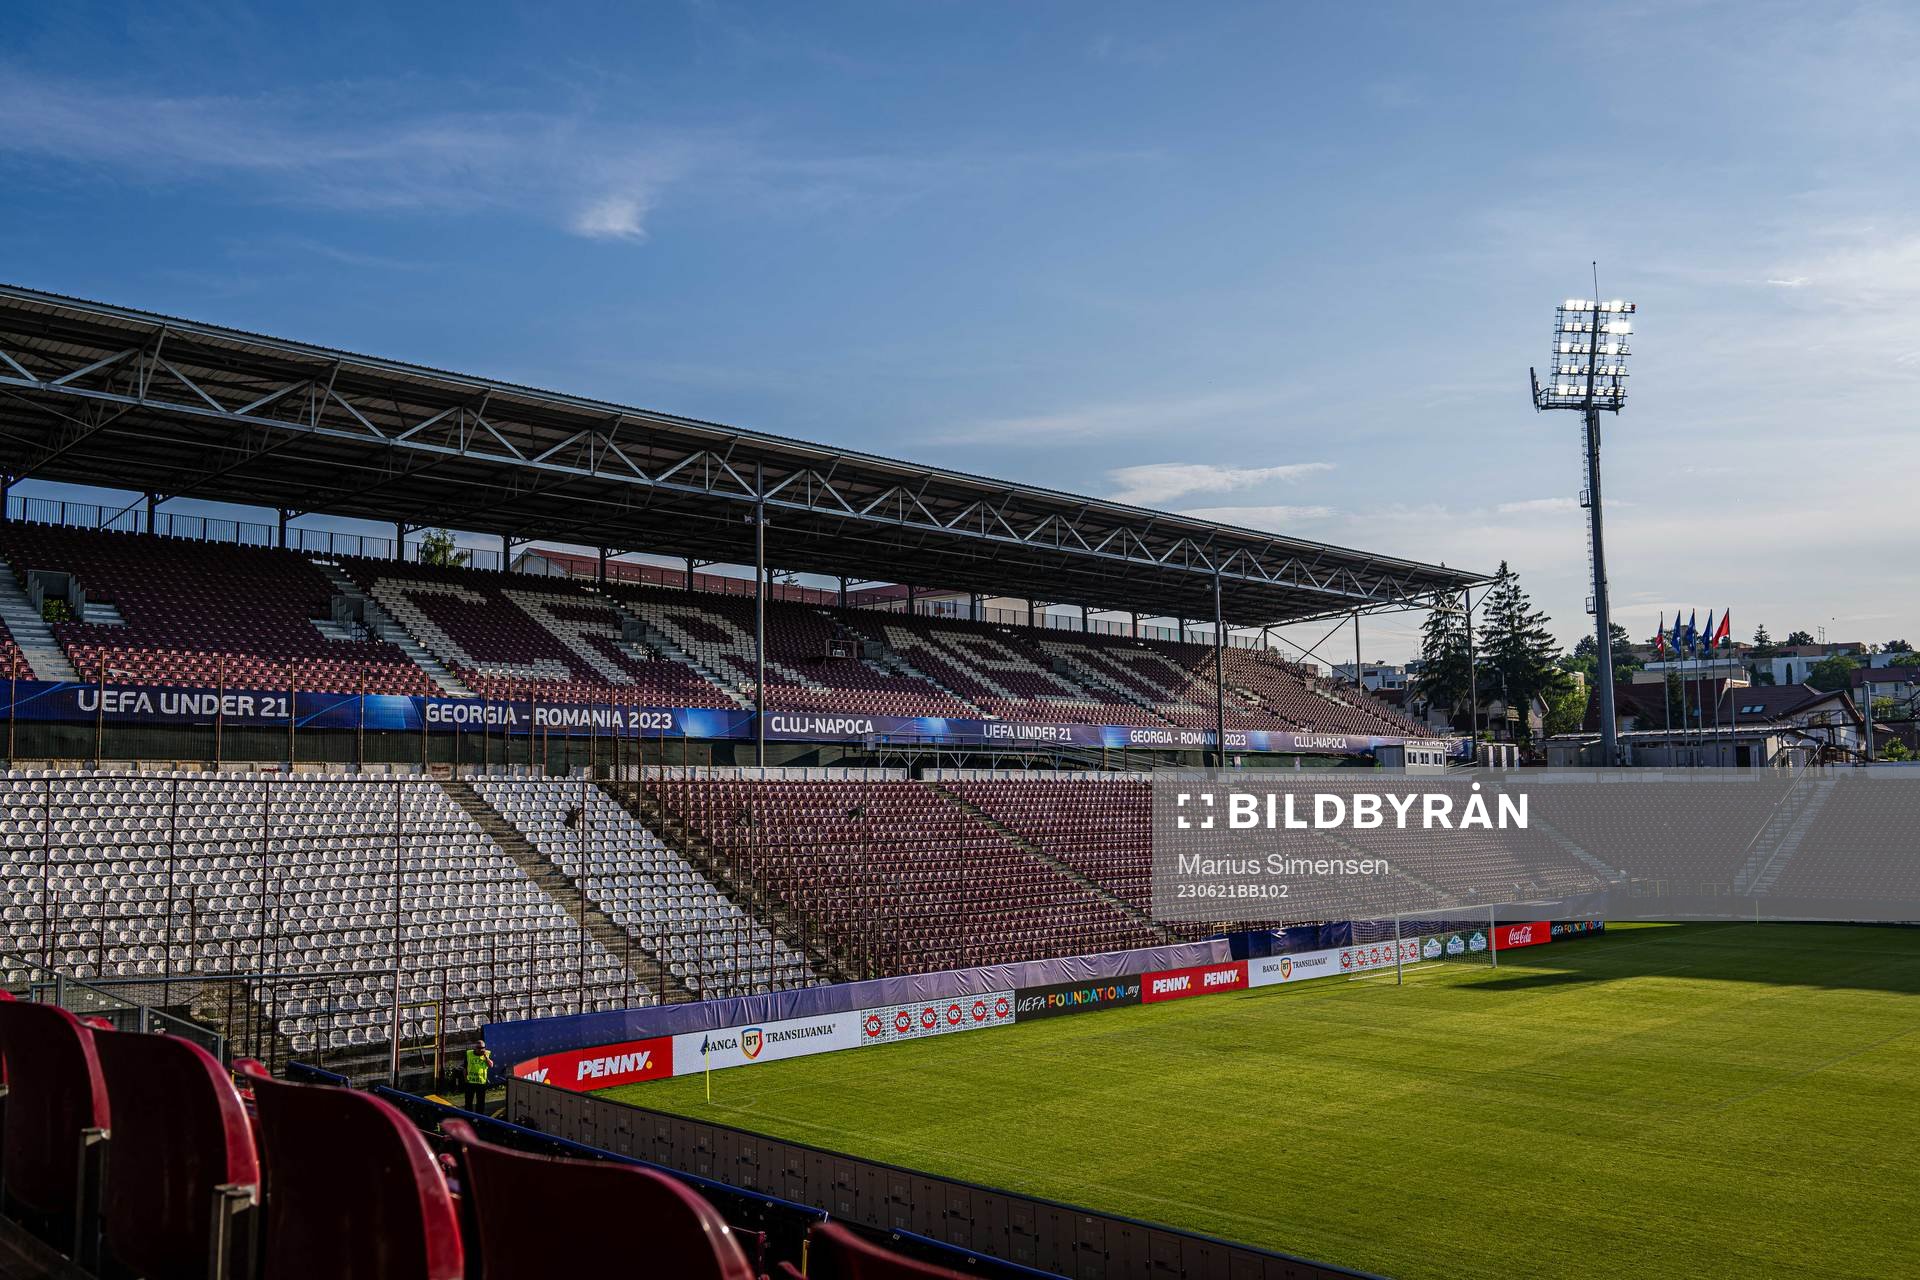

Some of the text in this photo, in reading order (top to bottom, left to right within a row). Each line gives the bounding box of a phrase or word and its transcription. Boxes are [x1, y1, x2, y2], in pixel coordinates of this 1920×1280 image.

[77, 689, 290, 718] UEFA UNDER 21
[425, 703, 518, 725] GEORGIA
[535, 707, 624, 728] ROMANIA
[629, 710, 673, 730] 2023
[771, 715, 874, 735] CLUJ-NAPOCA
[983, 724, 1072, 741] UEFA UNDER 21
[1130, 730, 1173, 743] GEORGIA
[1224, 734, 1246, 746] 2023
[1294, 735, 1347, 749] CLUJ-NAPOCA
[1445, 742, 1452, 752] 21
[1262, 963, 1280, 973] BANCA
[1017, 996, 1047, 1013] UEFA
[745, 1035, 759, 1046] BT
